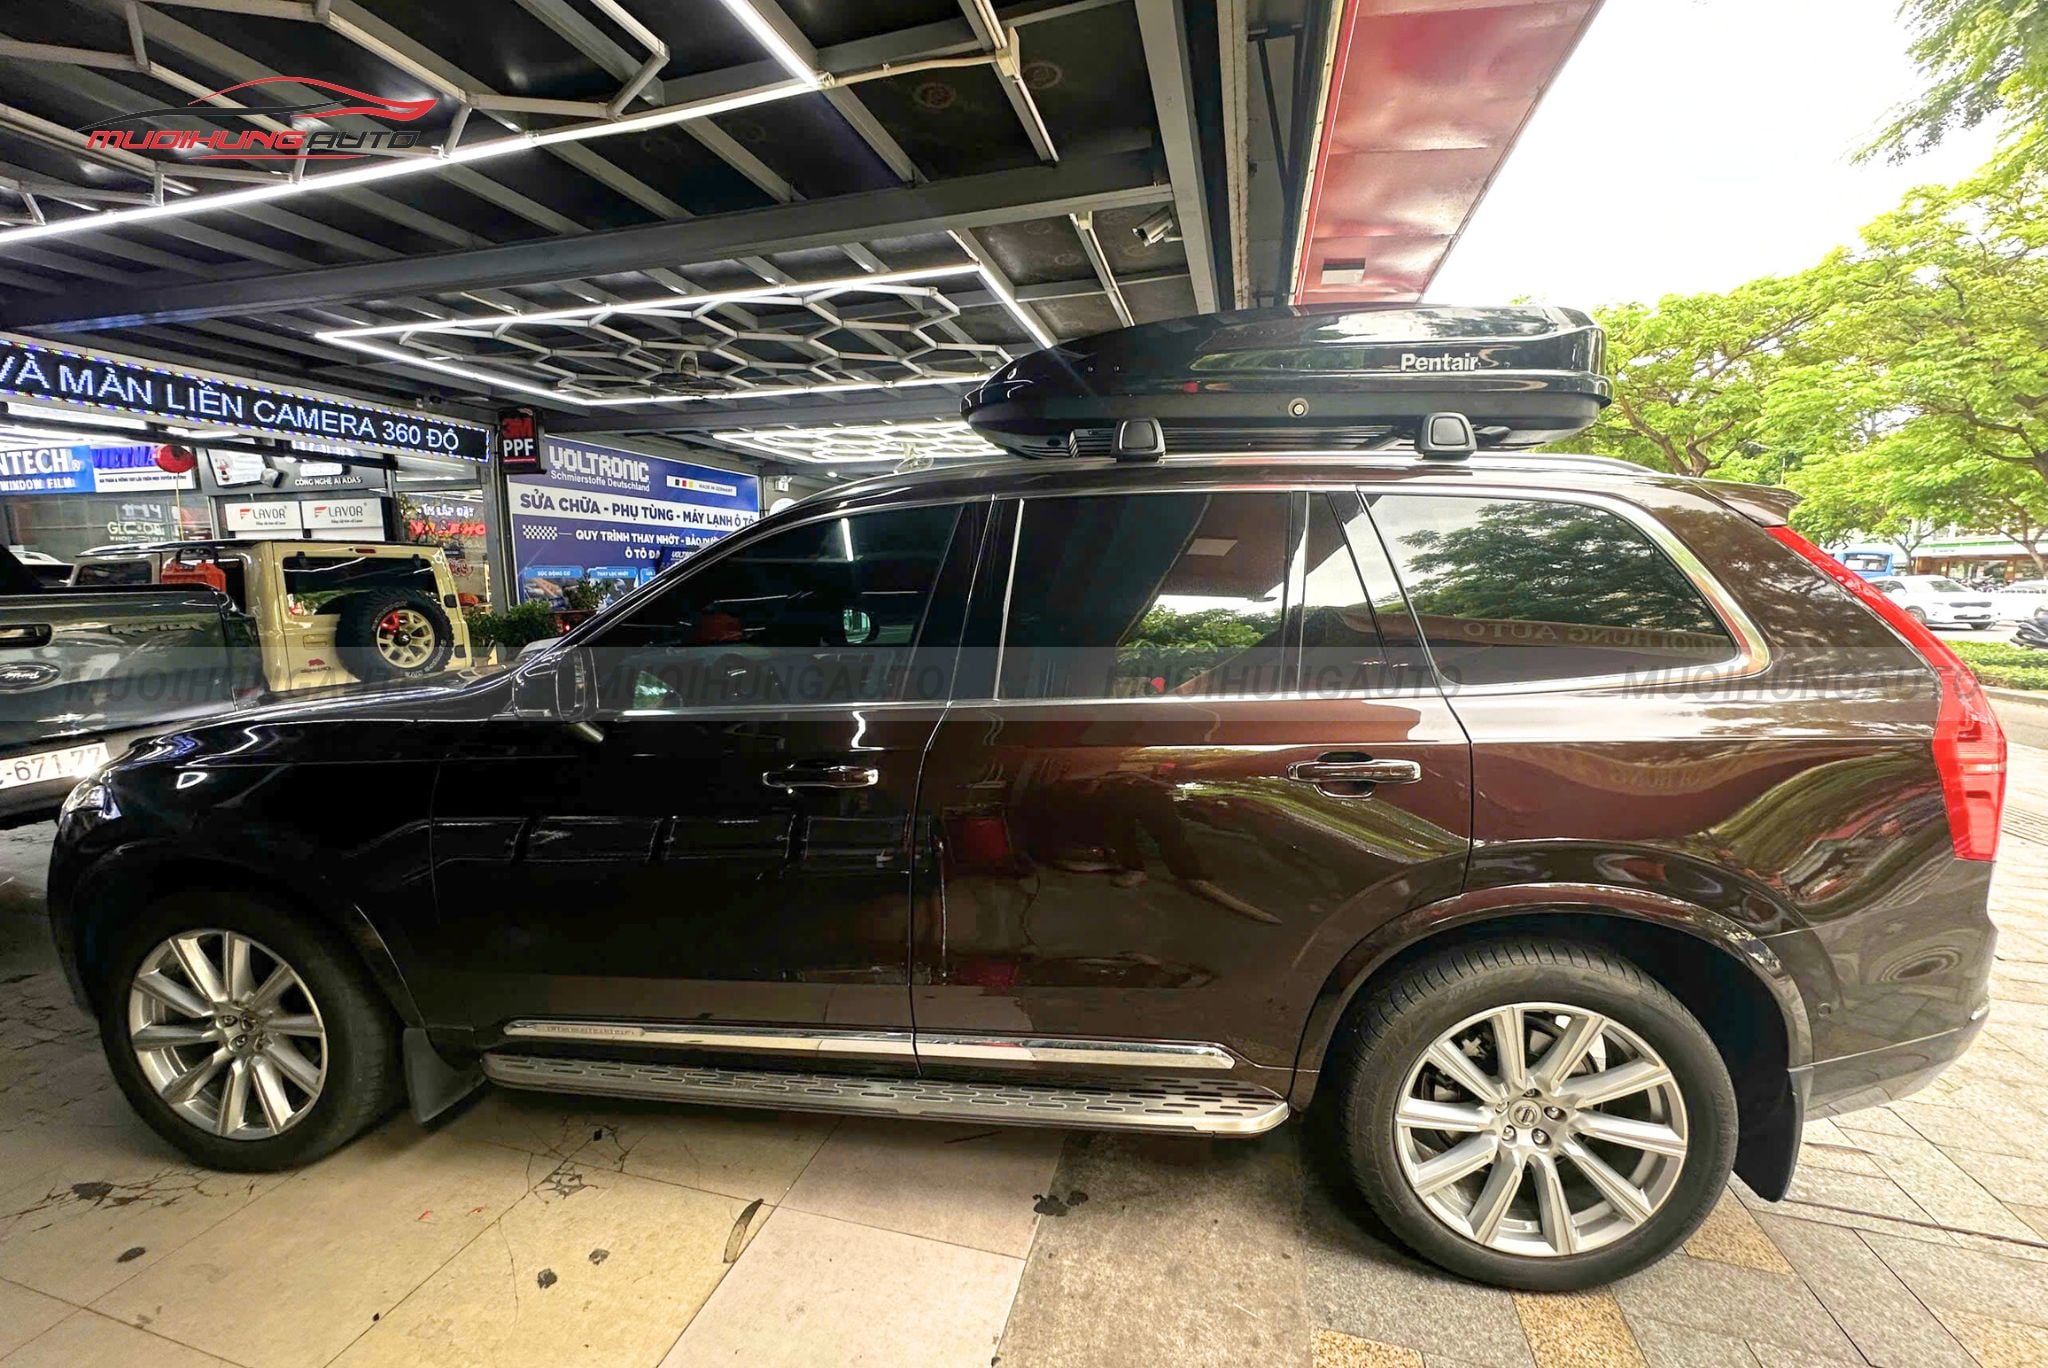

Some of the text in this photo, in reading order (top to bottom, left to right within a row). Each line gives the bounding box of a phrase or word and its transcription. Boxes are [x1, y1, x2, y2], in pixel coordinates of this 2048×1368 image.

[1400, 353, 1478, 372] Pentair
[59, 365, 152, 405] MÀN
[167, 380, 243, 419] LIỀN
[253, 400, 376, 438] CAMERA
[382, 420, 421, 445] 360
[426, 428, 459, 453] ĐỘ
[502, 418, 533, 437] 3M
[503, 438, 533, 457] PPF
[549, 445, 650, 483] VOLTRONIC
[551, 469, 650, 492] Schmierstoffe Deutschland
[253, 507, 286, 519] LAVOR
[328, 506, 363, 518] LAVOR
[520, 489, 555, 510] SỬA
[558, 495, 601, 514] CHỮA
[612, 503, 639, 522] PHỤ
[642, 503, 674, 521] TÙNG
[683, 508, 705, 524] MÁY
[707, 511, 733, 528] LẠNH
[575, 530, 598, 541] QUY
[600, 529, 629, 543] TRÌNH
[631, 533, 654, 545] THAY
[0, 747, 100, 784] -671.77
